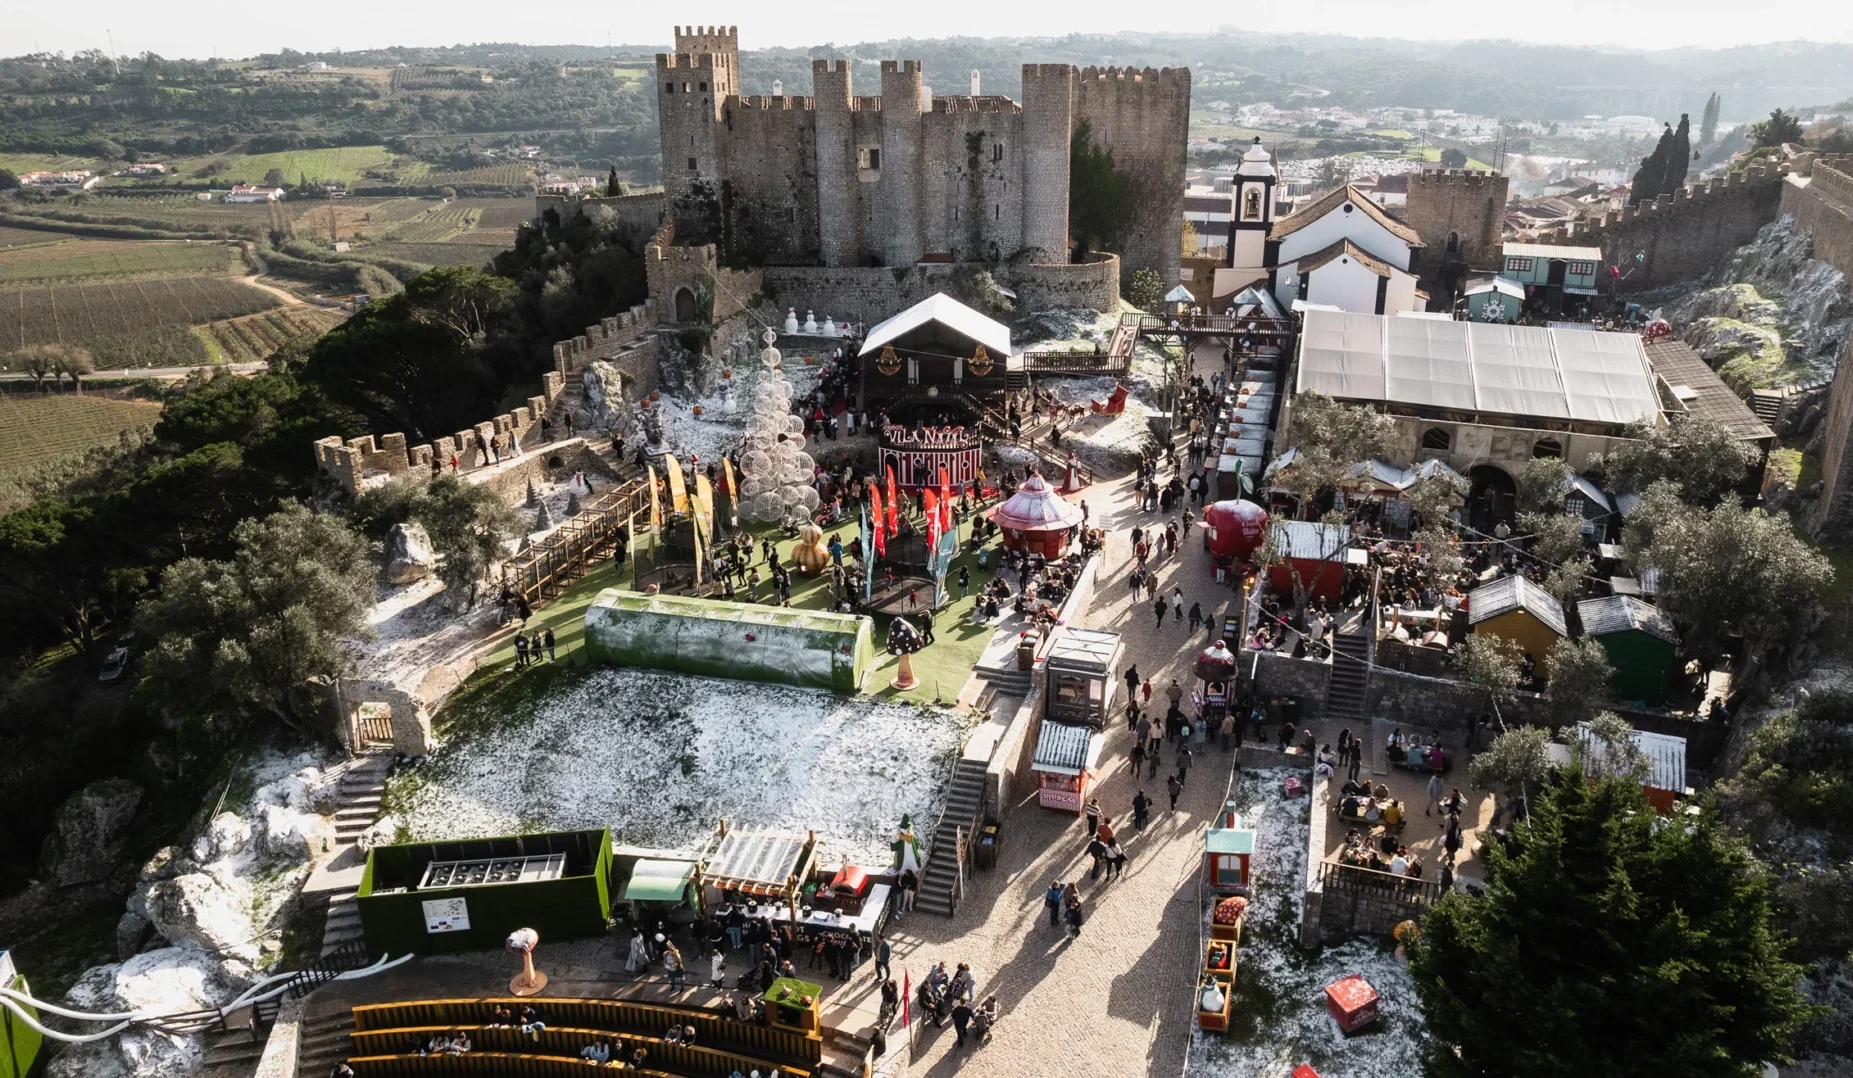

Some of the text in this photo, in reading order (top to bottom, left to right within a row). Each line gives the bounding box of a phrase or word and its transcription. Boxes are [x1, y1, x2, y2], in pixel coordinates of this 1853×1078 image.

[884, 426, 969, 449] VILA NATAL
[1043, 793, 1077, 804] PIPOCAS
